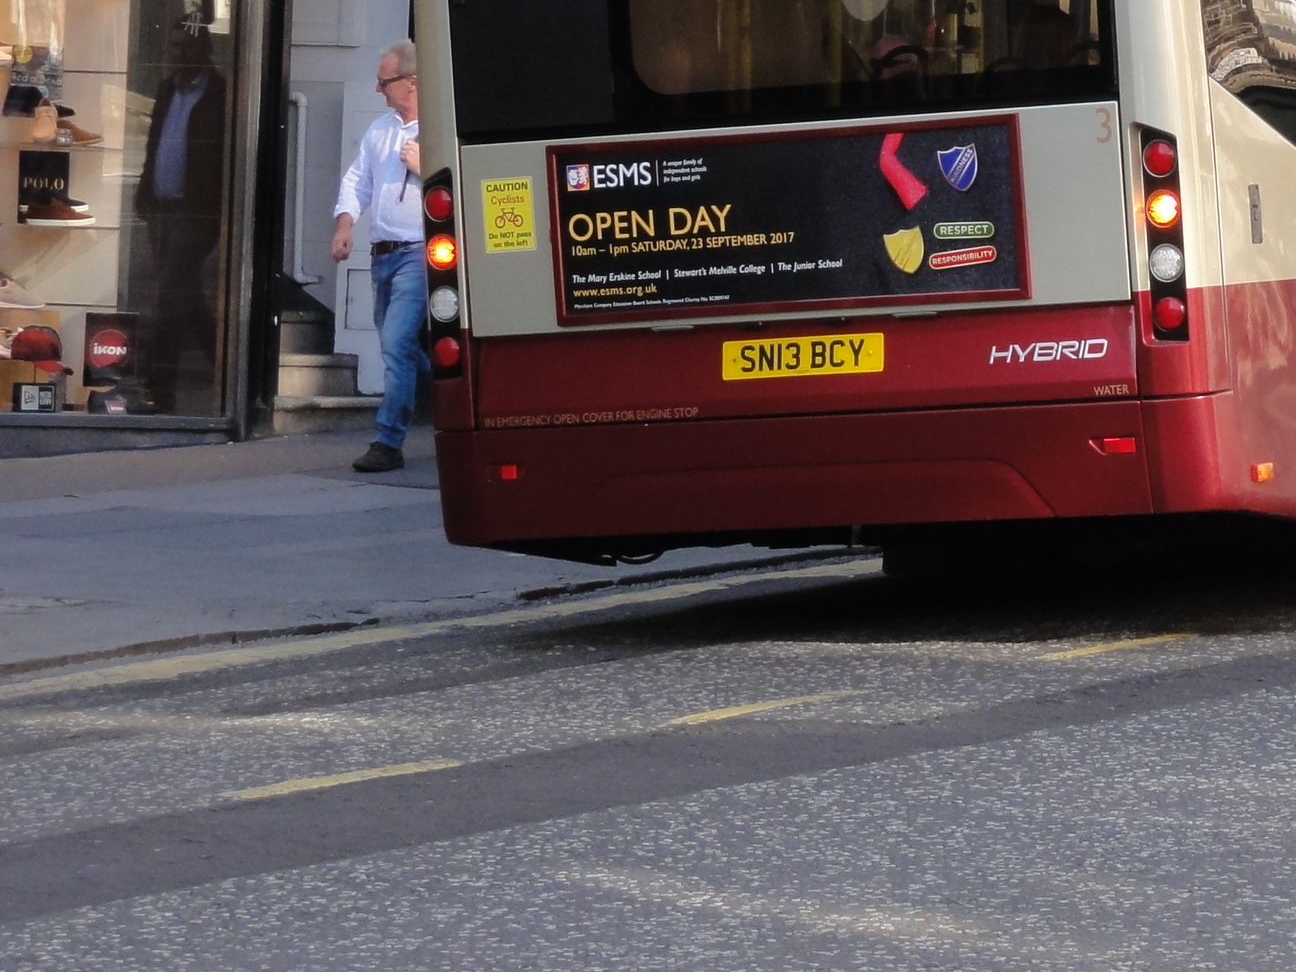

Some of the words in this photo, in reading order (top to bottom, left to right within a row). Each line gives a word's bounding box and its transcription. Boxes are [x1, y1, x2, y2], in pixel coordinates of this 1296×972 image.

[1096, 109, 1112, 143] 3
[593, 162, 651, 188] ESMS
[950, 148, 973, 183] KINDNESS
[24, 177, 64, 190] POLO
[486, 182, 528, 192] CAUTION
[491, 195, 524, 206] Cyclists
[568, 209, 655, 242] OPEN
[669, 204, 732, 235] DAY
[940, 224, 989, 236] RESPECT
[571, 244, 596, 256] 10am
[608, 244, 629, 257] 1pm
[631, 238, 690, 254] SATURDAY,
[691, 237, 703, 250] 23
[706, 233, 767, 248] SEPTEMBER
[770, 232, 795, 245] 2017
[932, 249, 993, 266] RESPONSIBILITY
[572, 274, 586, 284] The
[587, 273, 607, 285] Mary
[608, 271, 635, 282] Erskine
[637, 270, 662, 281] School
[708, 265, 737, 276] Melville
[739, 264, 766, 276] College
[777, 261, 792, 271] The
[793, 261, 816, 272] Junior
[818, 259, 843, 269] School
[573, 283, 657, 298] www.esms.org.uk
[740, 343, 800, 372] SN13
[810, 338, 865, 368] BCY
[989, 338, 1108, 364] HYBRID
[1093, 384, 1129, 396] WATER
[484, 417, 495, 428] IN
[497, 415, 551, 427] EMERGENCY
[553, 413, 580, 425] OPEN
[582, 412, 614, 423] COVER
[616, 410, 634, 422] FOR
[637, 409, 672, 420] ENGINE
[674, 407, 699, 418] STOP
